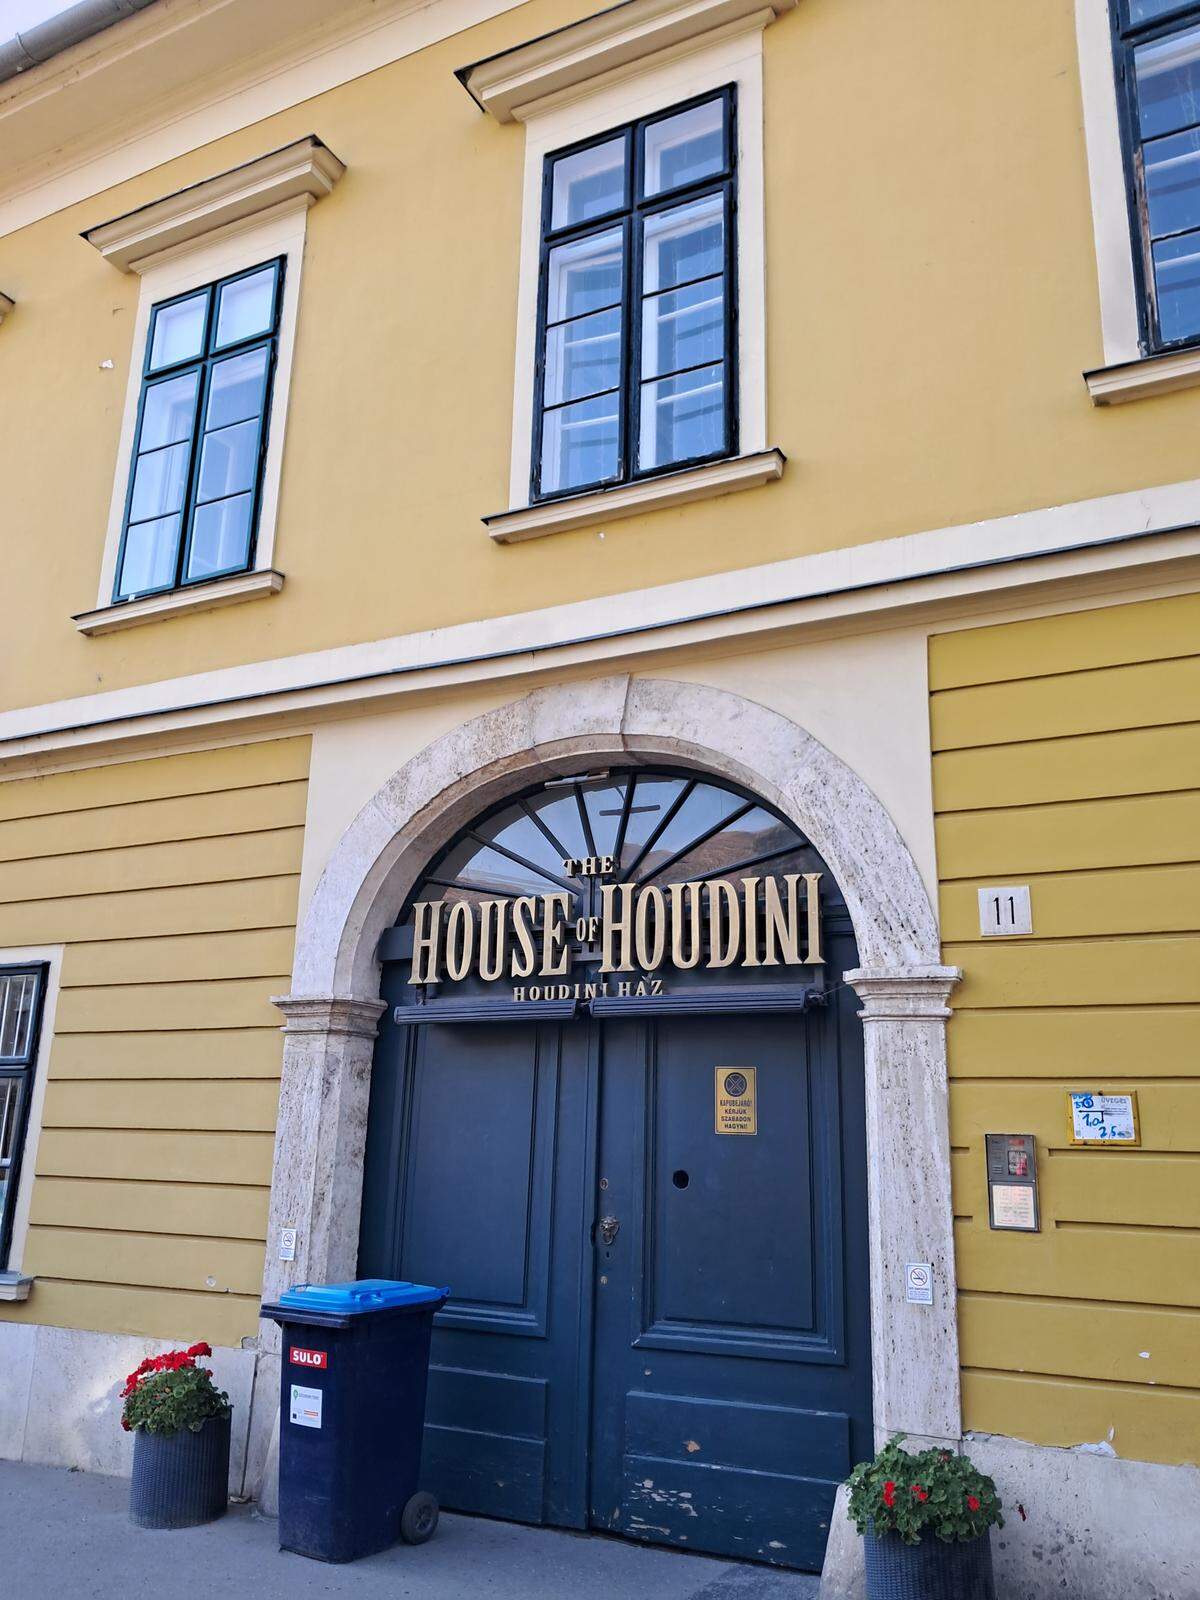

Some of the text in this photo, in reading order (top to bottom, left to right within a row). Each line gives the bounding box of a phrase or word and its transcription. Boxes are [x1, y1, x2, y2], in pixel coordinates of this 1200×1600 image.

[563, 855, 616, 878] THE
[993, 896, 1015, 926] 11
[407, 872, 826, 984] HOUSE OF HOUDINI
[513, 982, 609, 1002] HOUDINI
[293, 1350, 322, 1365] SULO
